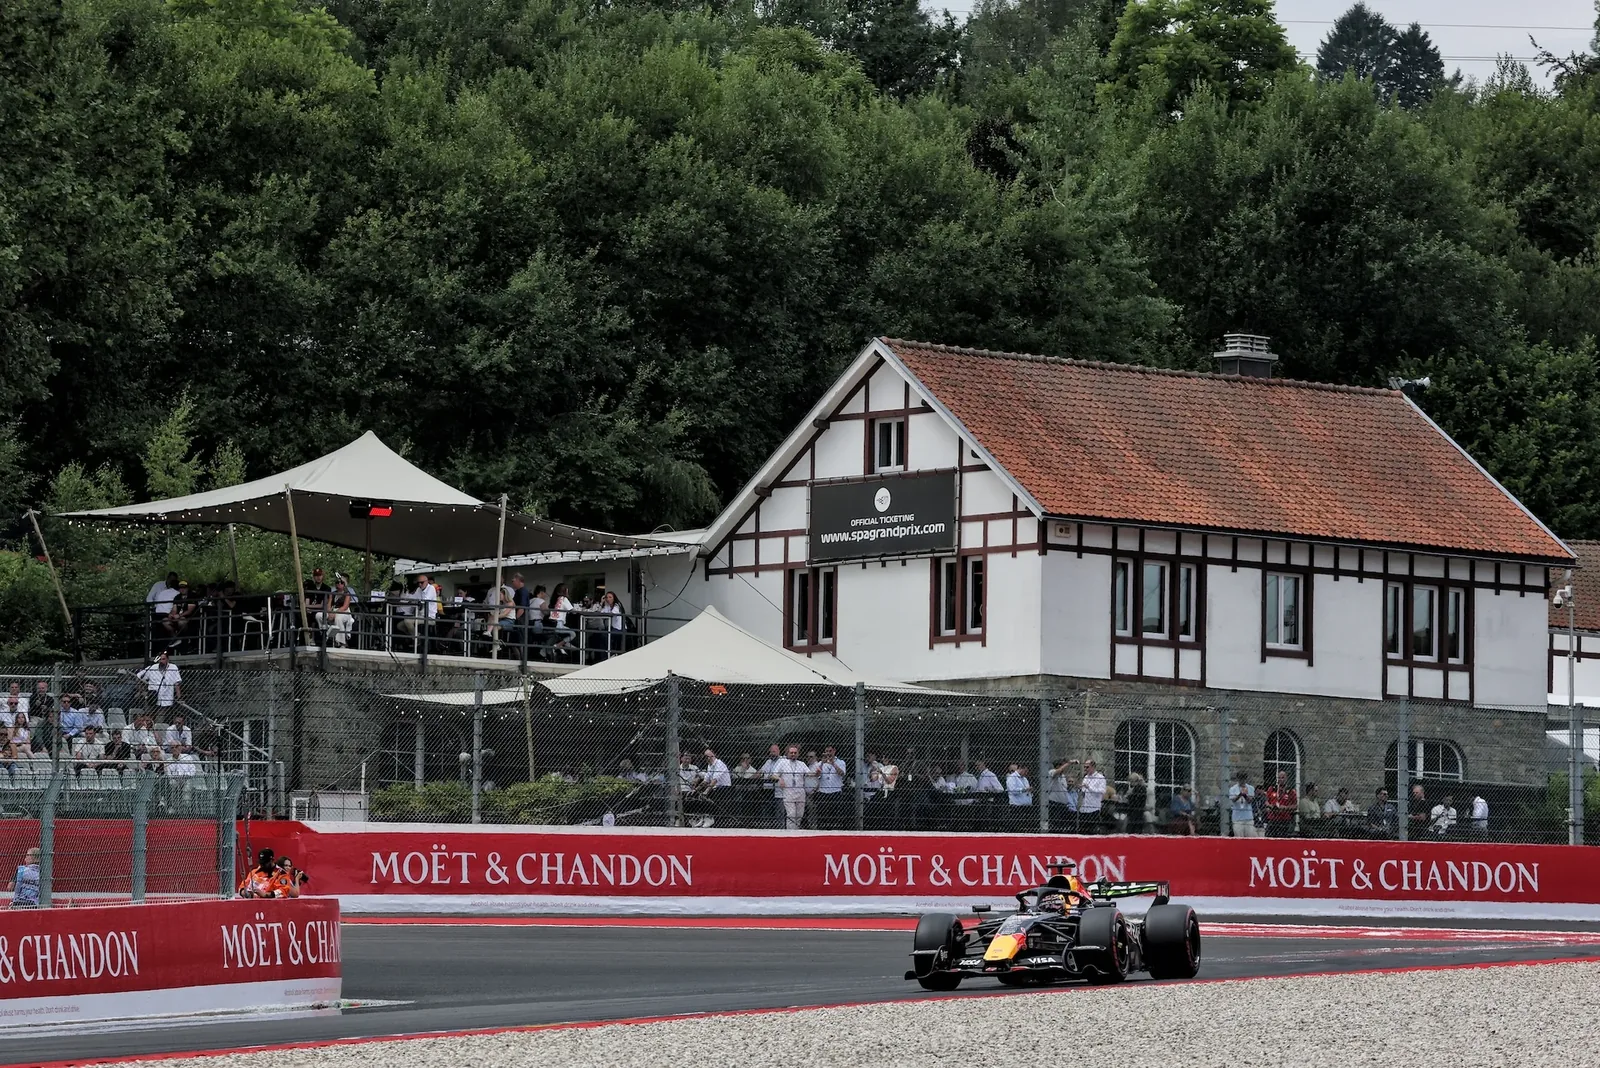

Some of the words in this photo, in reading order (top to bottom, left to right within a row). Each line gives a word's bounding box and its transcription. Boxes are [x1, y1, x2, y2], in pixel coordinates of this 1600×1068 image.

[820, 522, 946, 544] www.spagrandprix.com
[850, 517, 879, 527] OFFICIAL
[879, 513, 915, 524] TICKETING
[370, 843, 477, 885] MOËT
[485, 851, 510, 885] &
[515, 852, 693, 887] CHANDON
[823, 846, 921, 886] MOËT
[928, 853, 952, 887] &
[1249, 849, 1344, 890] MOËT
[1351, 858, 1373, 890] &
[1378, 859, 1539, 893] CHANDON
[0, 935, 16, 983] &
[18, 931, 139, 982] CHANDON
[221, 911, 283, 968] MOËT
[288, 920, 304, 965] &
[1027, 956, 1057, 964] VISA
